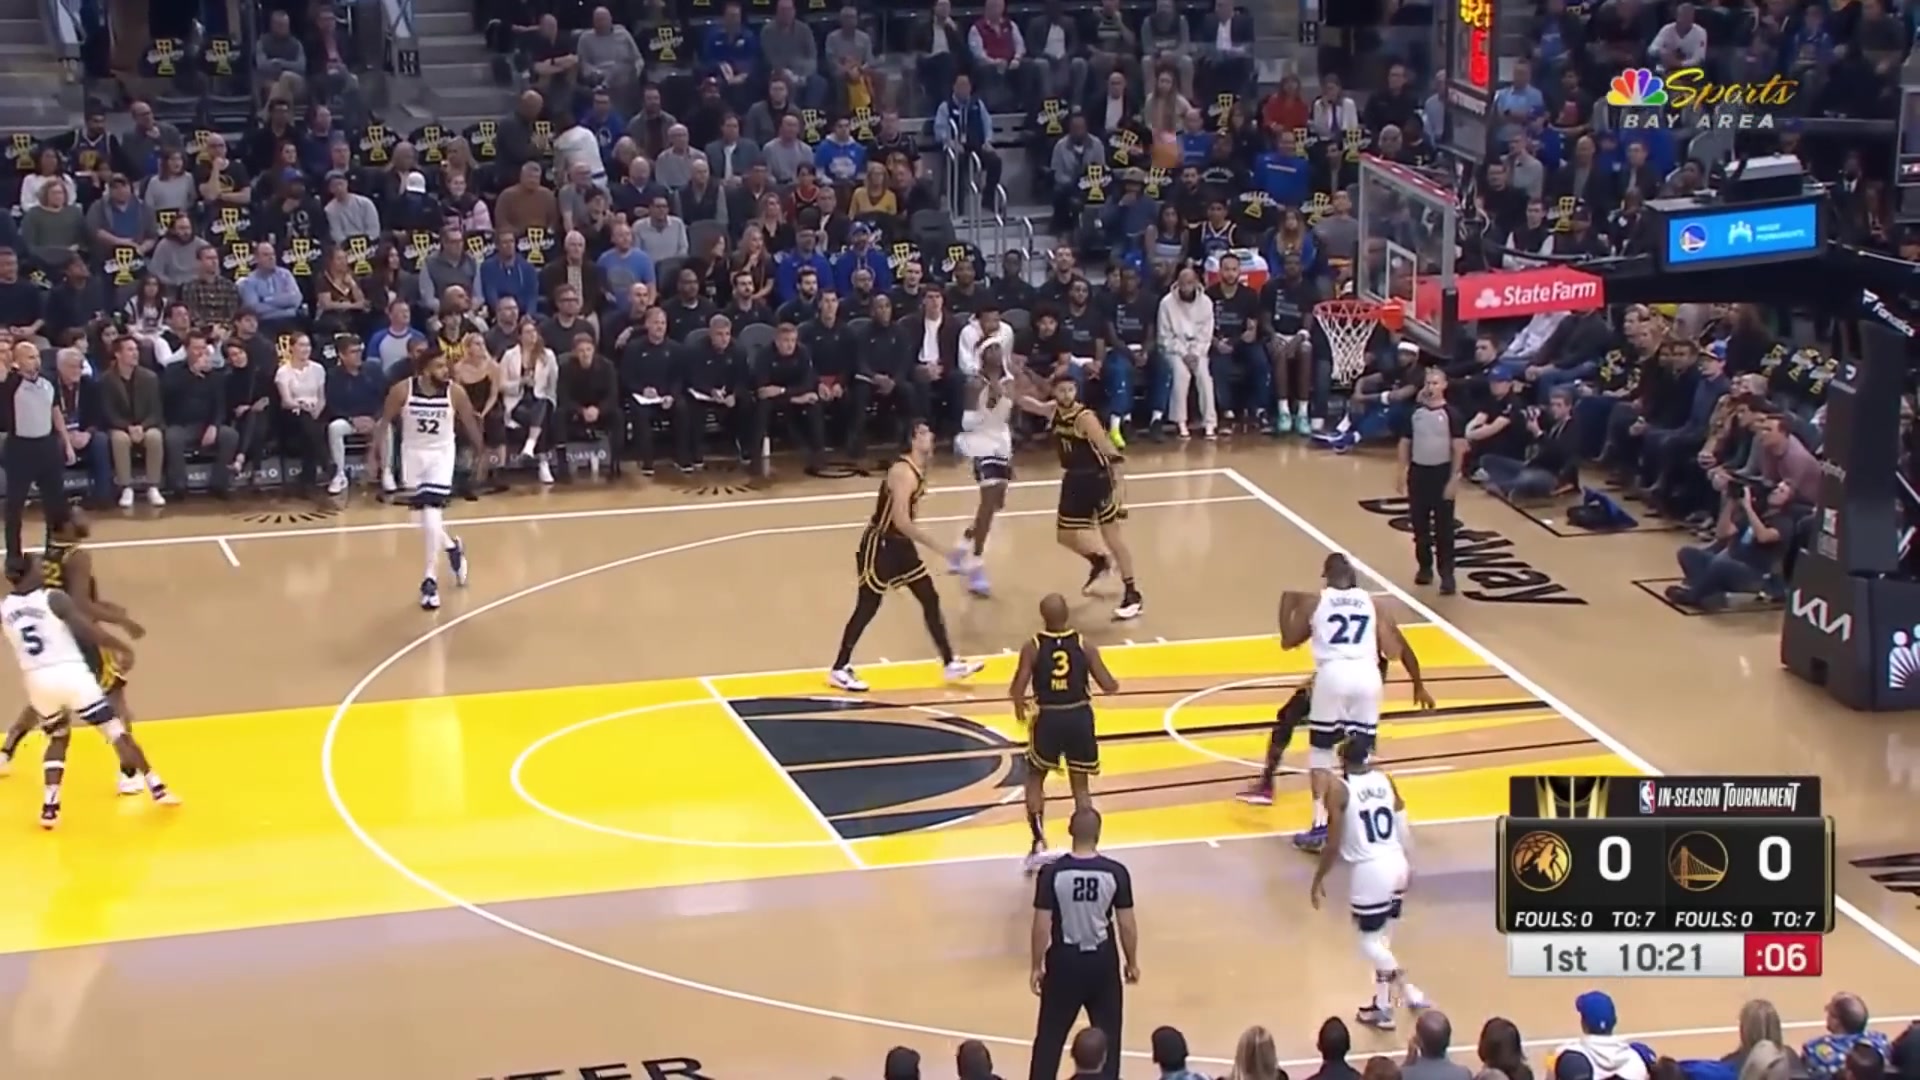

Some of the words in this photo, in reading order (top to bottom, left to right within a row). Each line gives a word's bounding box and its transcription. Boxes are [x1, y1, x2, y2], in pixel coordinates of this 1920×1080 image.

[1503, 283, 1550, 306] State
[1552, 281, 1597, 302] Farm
[417, 418, 440, 434] 32
[20, 624, 45, 656] 5
[1327, 613, 1369, 644] 27
[1051, 650, 1070, 677] 3
[1359, 806, 1393, 843] 10
[1072, 876, 1099, 902] 28
